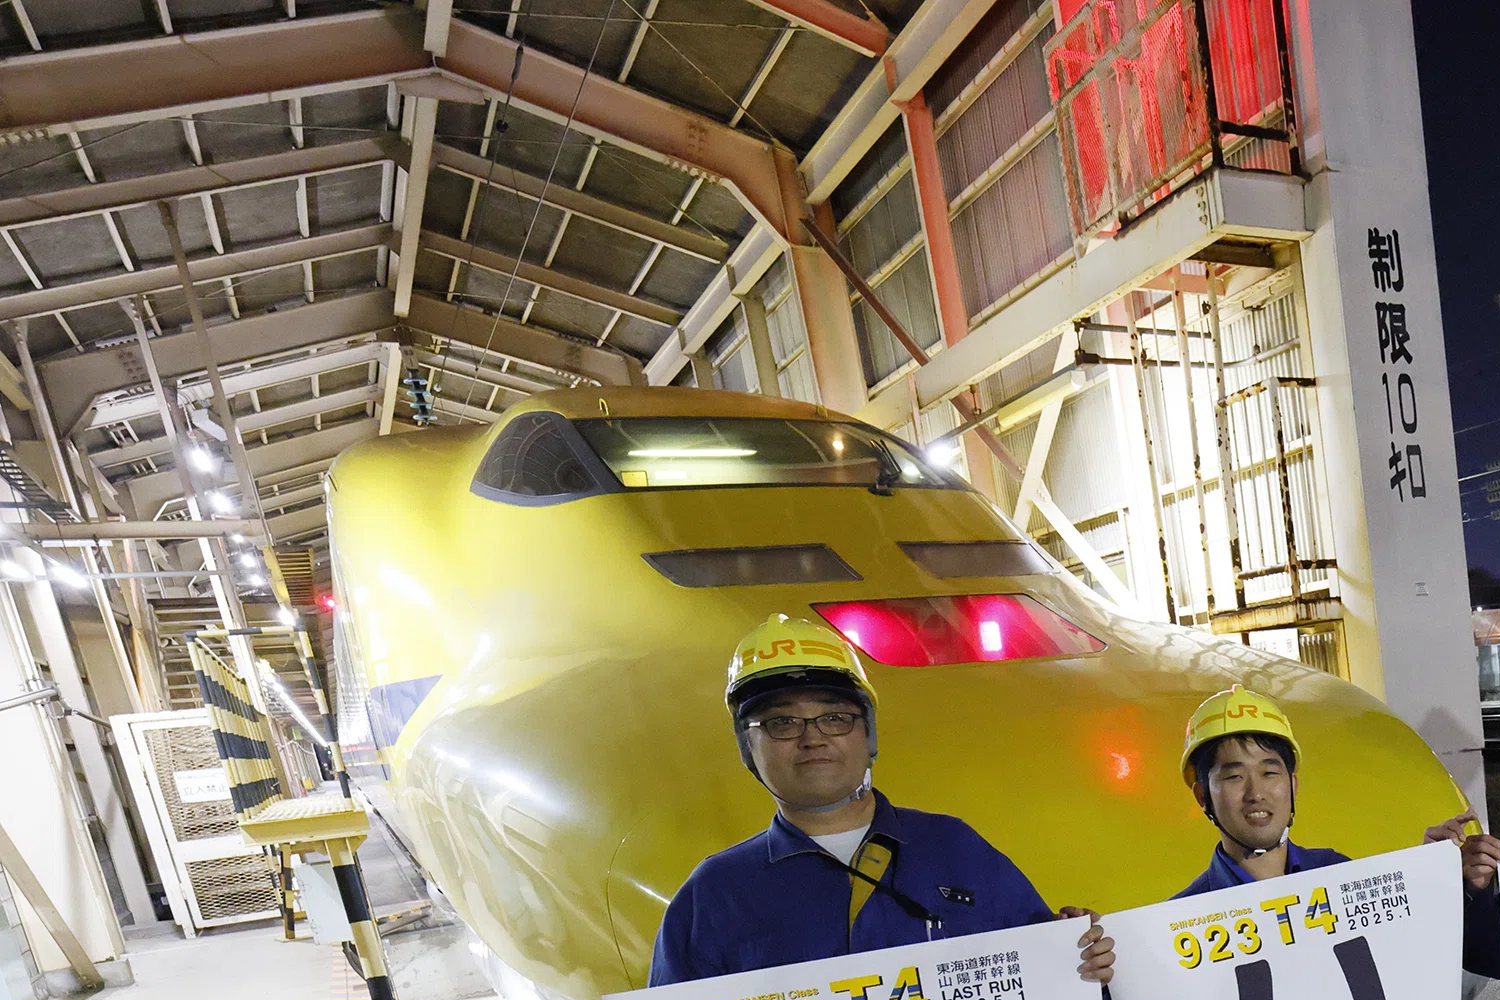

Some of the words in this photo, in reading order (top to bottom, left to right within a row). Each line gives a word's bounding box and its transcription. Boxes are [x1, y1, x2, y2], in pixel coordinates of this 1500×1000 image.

[758, 639, 795, 660] JR
[1227, 704, 1258, 719] JR
[1340, 871, 1404, 895] 東海道新幹線
[1345, 901, 1378, 918] LAST
[1382, 894, 1408, 909] RUN
[1169, 912, 1227, 931] SHINKANSEN
[1173, 918, 1262, 969] 923
[1260, 887, 1338, 945] T4
[1348, 906, 1411, 931] 2025.1
[936, 951, 1019, 975] 東海道新幹線
[787, 986, 819, 1000] Class
[989, 977, 1023, 994] RUN
